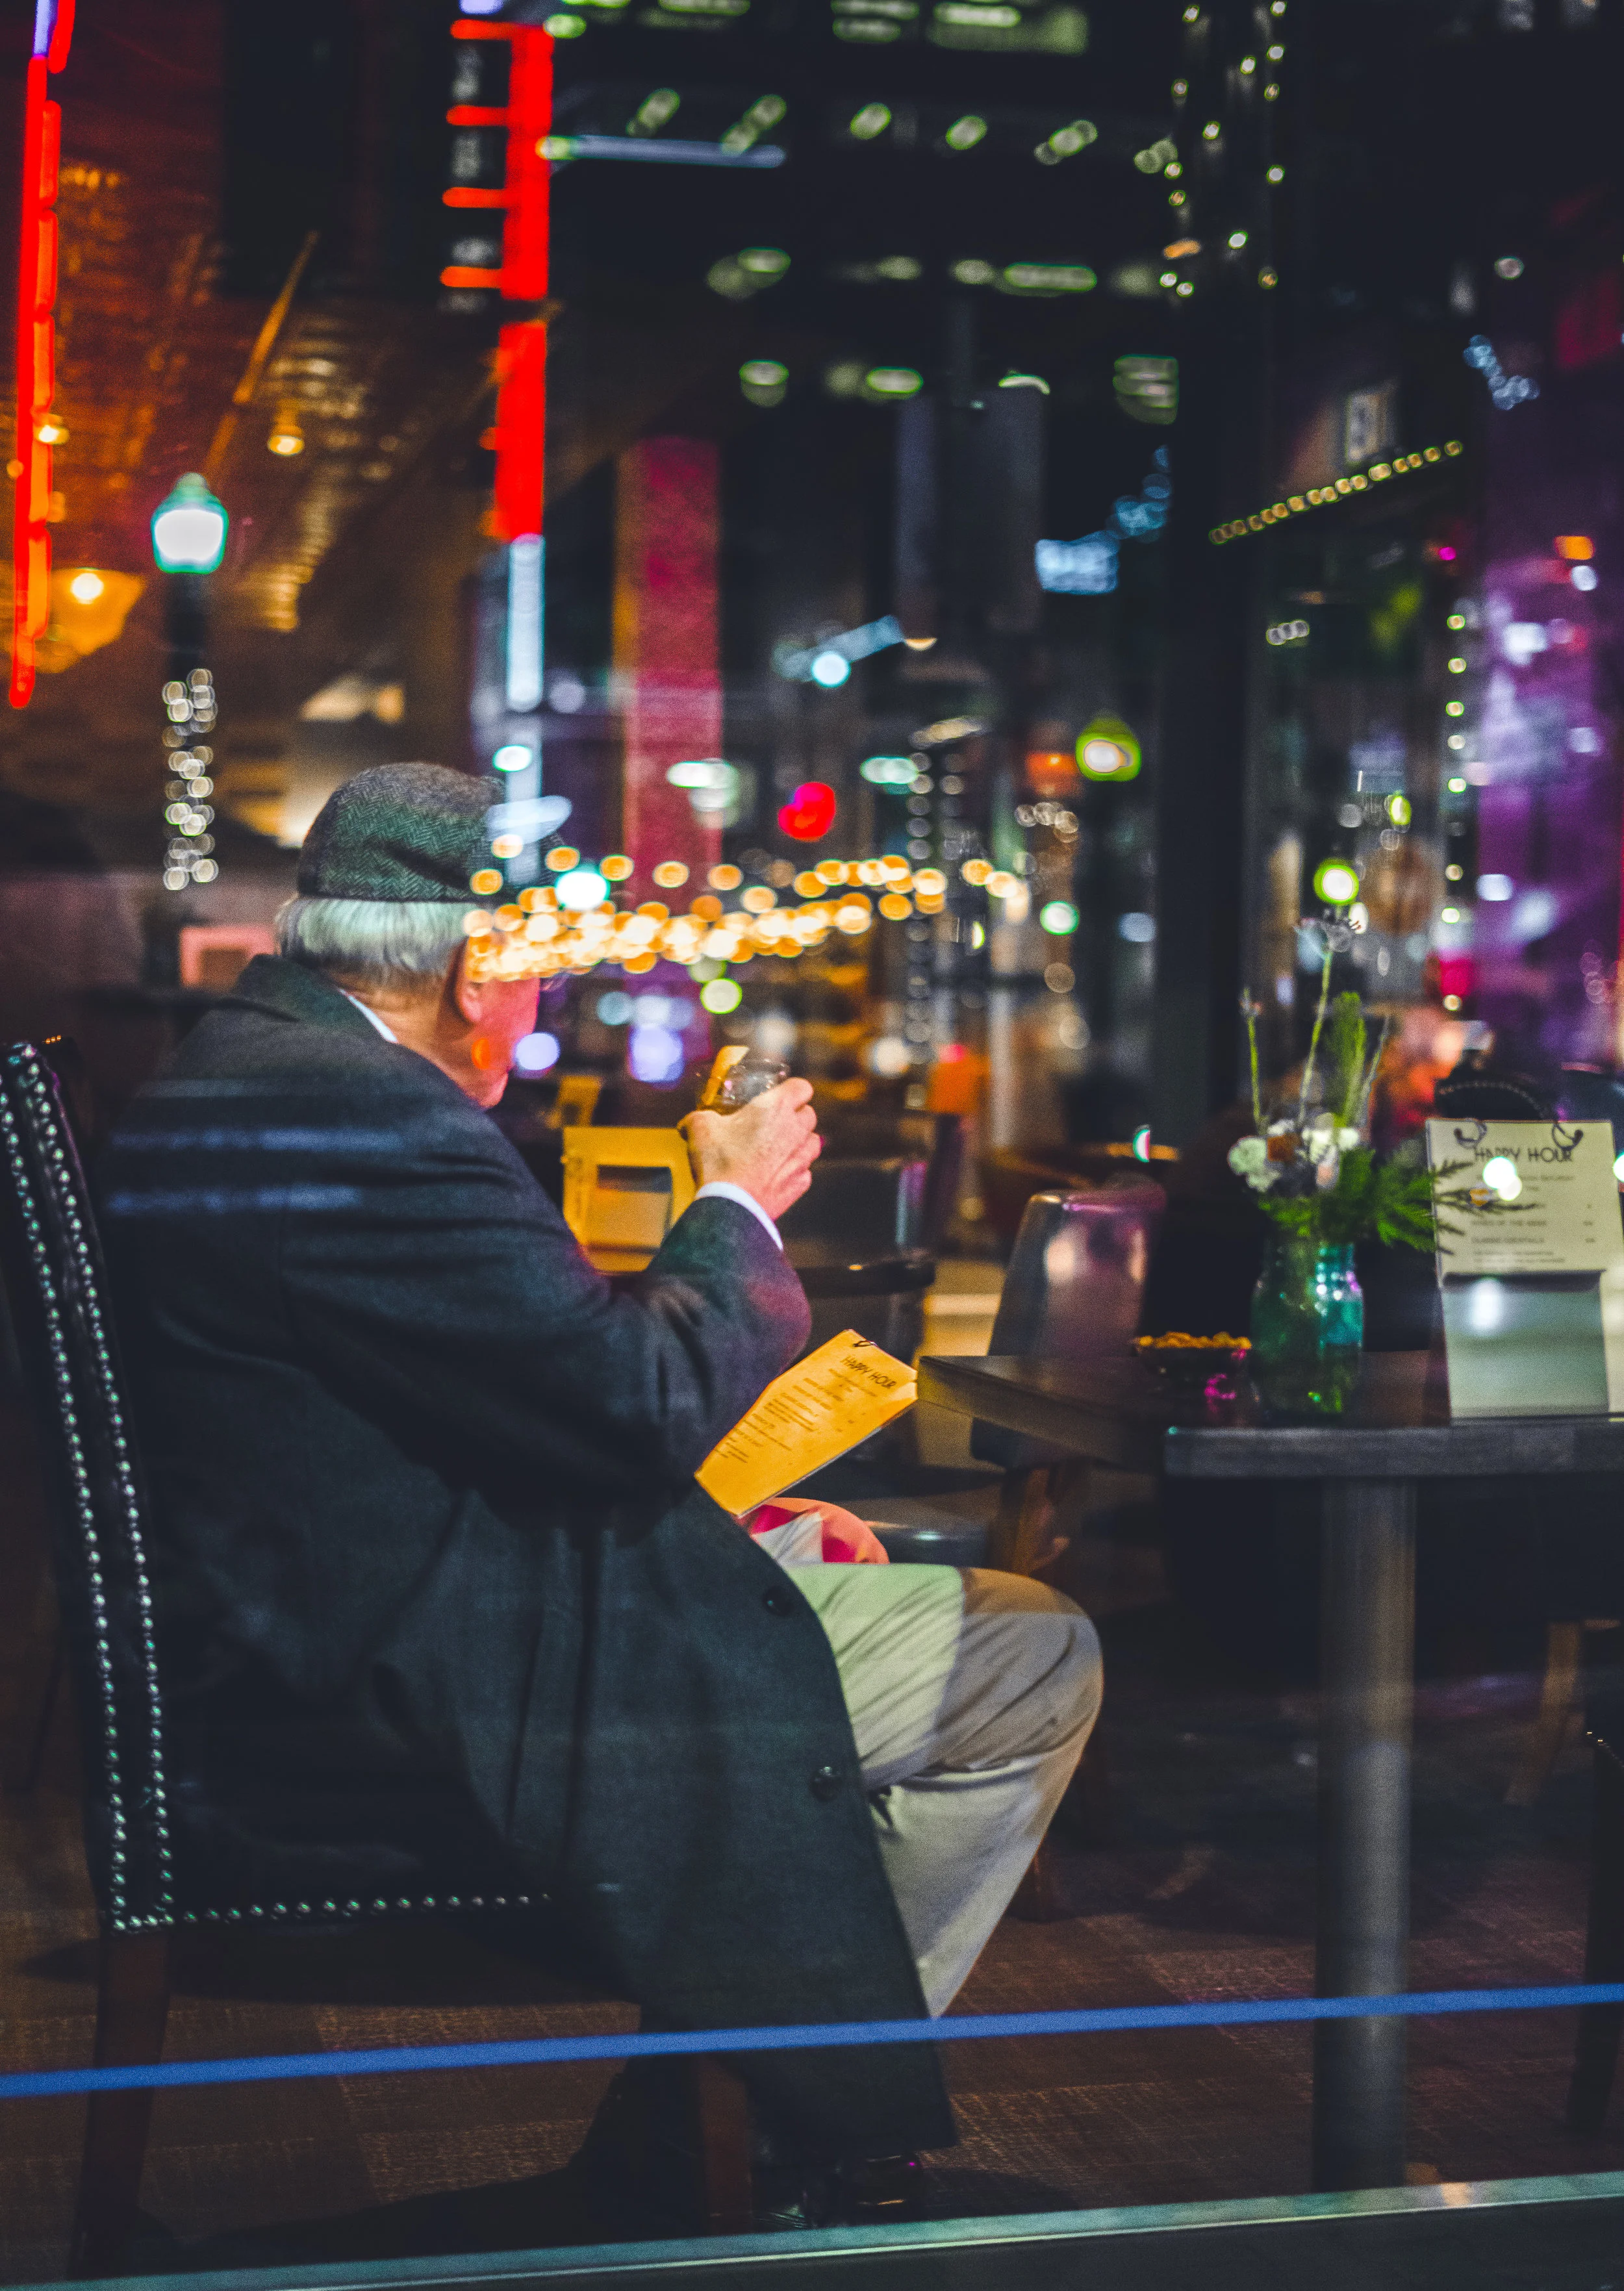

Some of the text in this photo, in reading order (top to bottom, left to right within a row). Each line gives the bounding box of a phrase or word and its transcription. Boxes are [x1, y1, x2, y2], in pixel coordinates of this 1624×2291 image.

[1474, 1147, 1573, 1163] HAPPY HOUR
[840, 1356, 872, 1374] HAPPY
[868, 1371, 897, 1389] HOUR
